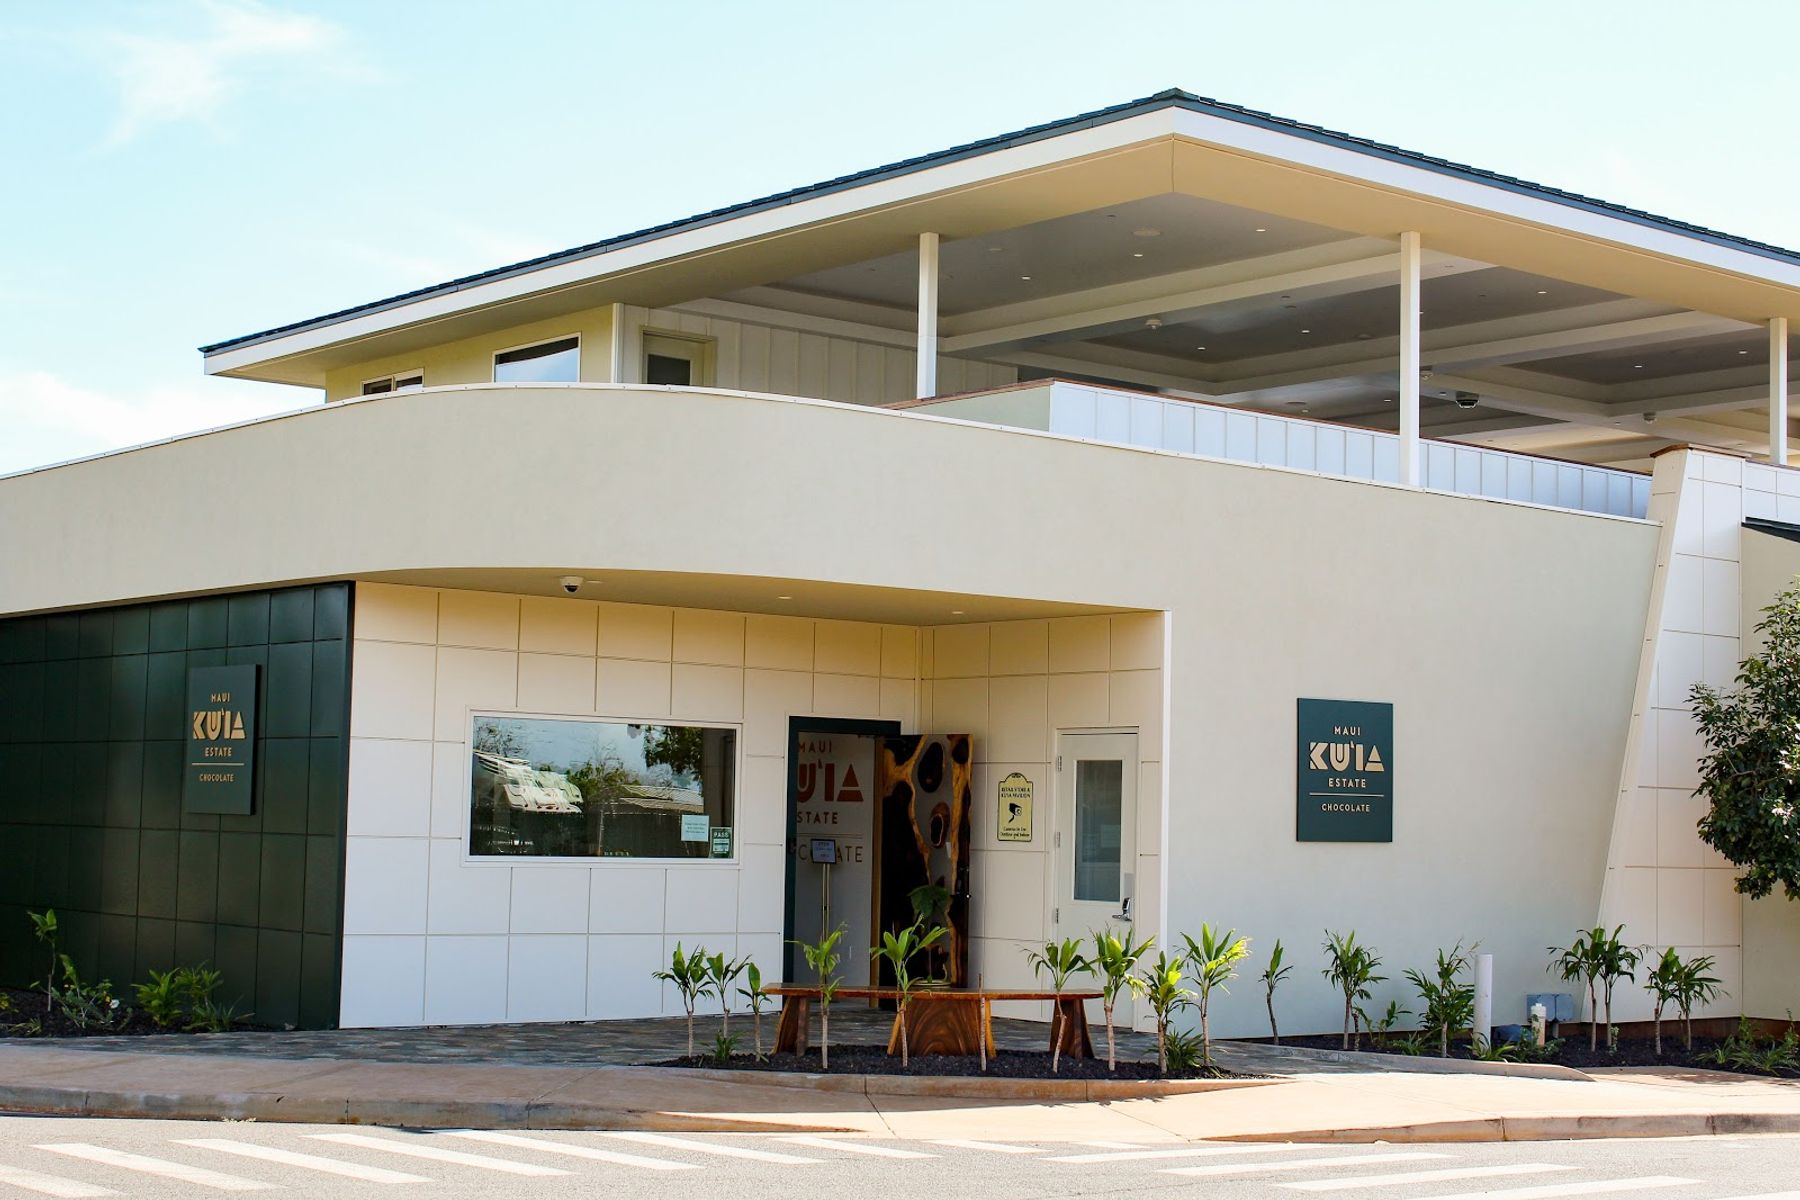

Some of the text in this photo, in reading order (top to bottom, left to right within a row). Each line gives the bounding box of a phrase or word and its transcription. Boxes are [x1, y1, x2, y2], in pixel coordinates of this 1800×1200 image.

[211, 692, 231, 703] MAUI
[1334, 726, 1361, 736] MAUI
[204, 747, 232, 757] ESTATE
[199, 773, 234, 782] CHOCOLATE
[1328, 777, 1366, 788] ESTATE
[1321, 803, 1370, 812] CHOCOLATE
